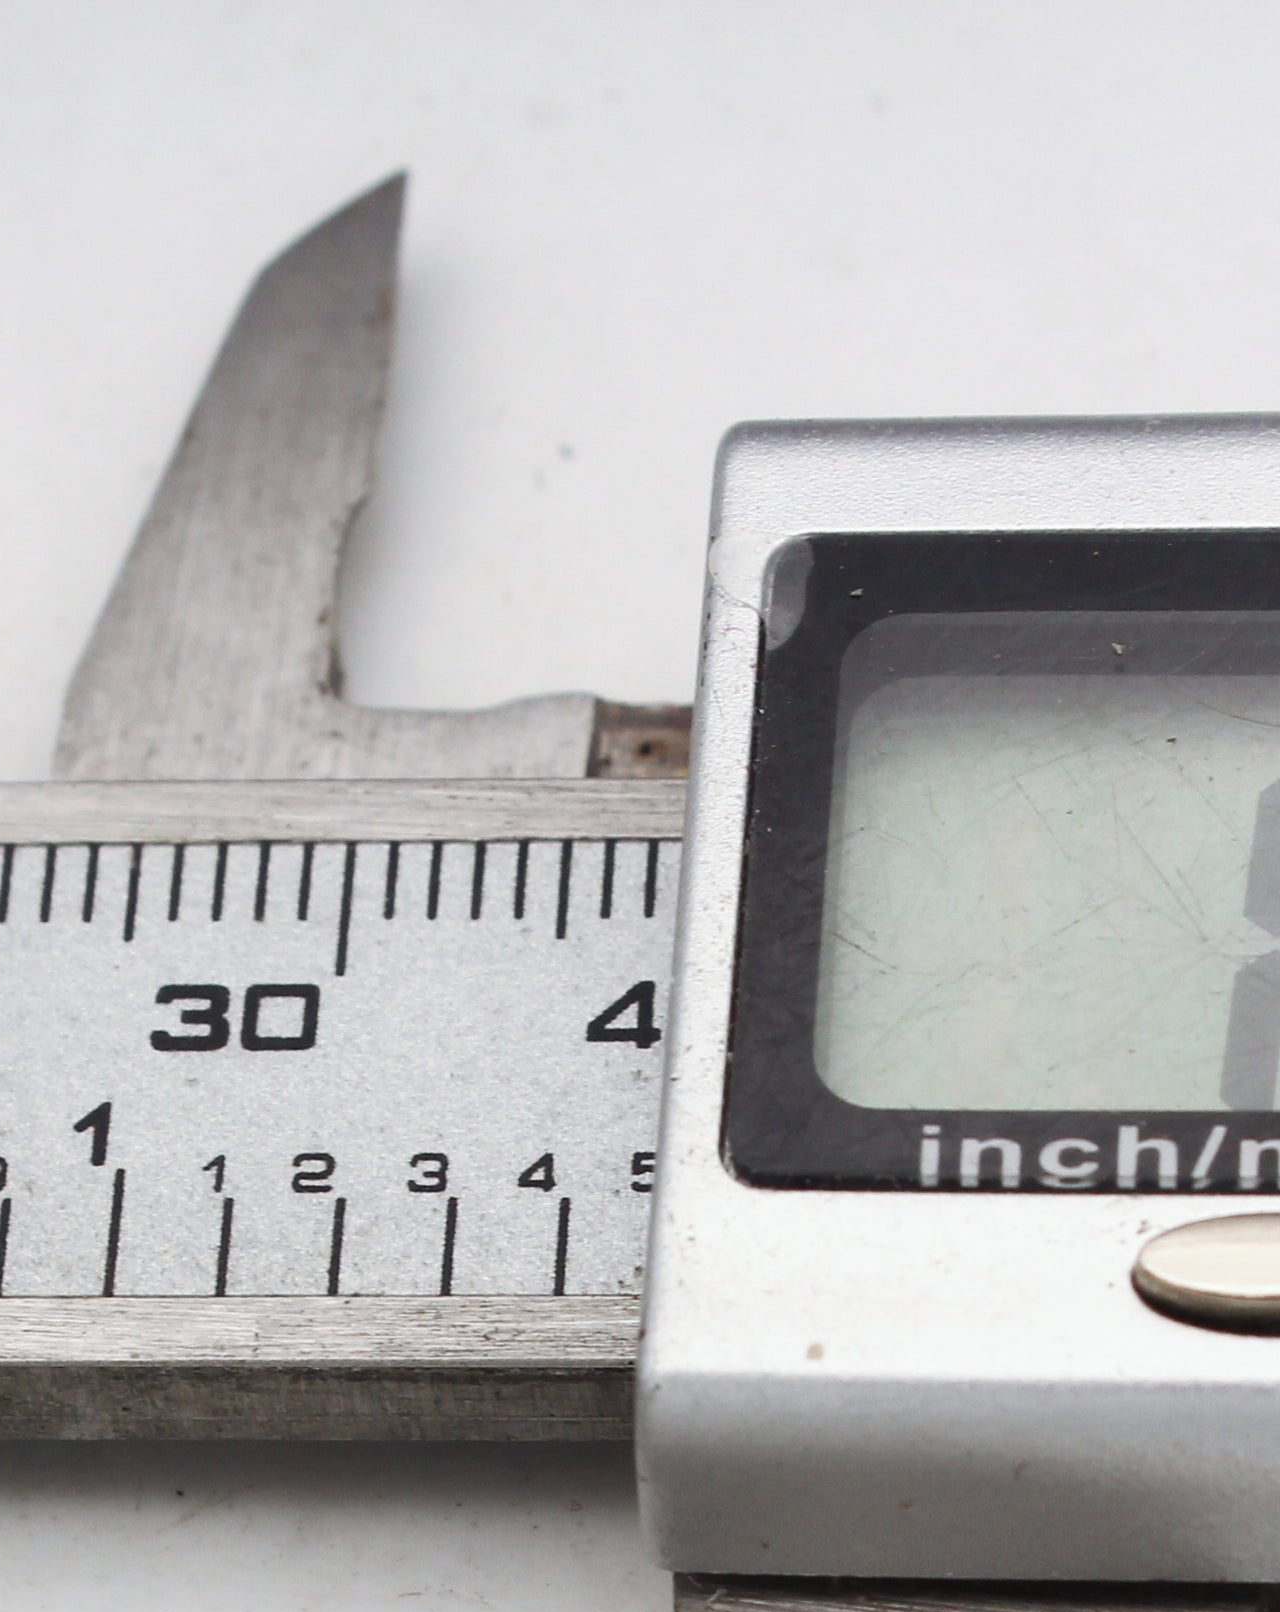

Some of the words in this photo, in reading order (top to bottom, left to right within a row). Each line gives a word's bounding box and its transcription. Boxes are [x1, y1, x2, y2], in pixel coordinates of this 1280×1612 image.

[150, 984, 320, 1051] 30
[74, 1102, 112, 1165] 1
[201, 1155, 228, 1193] 1
[291, 1152, 336, 1193] 2
[407, 1152, 449, 1193] 3
[517, 1152, 558, 1192] 4
